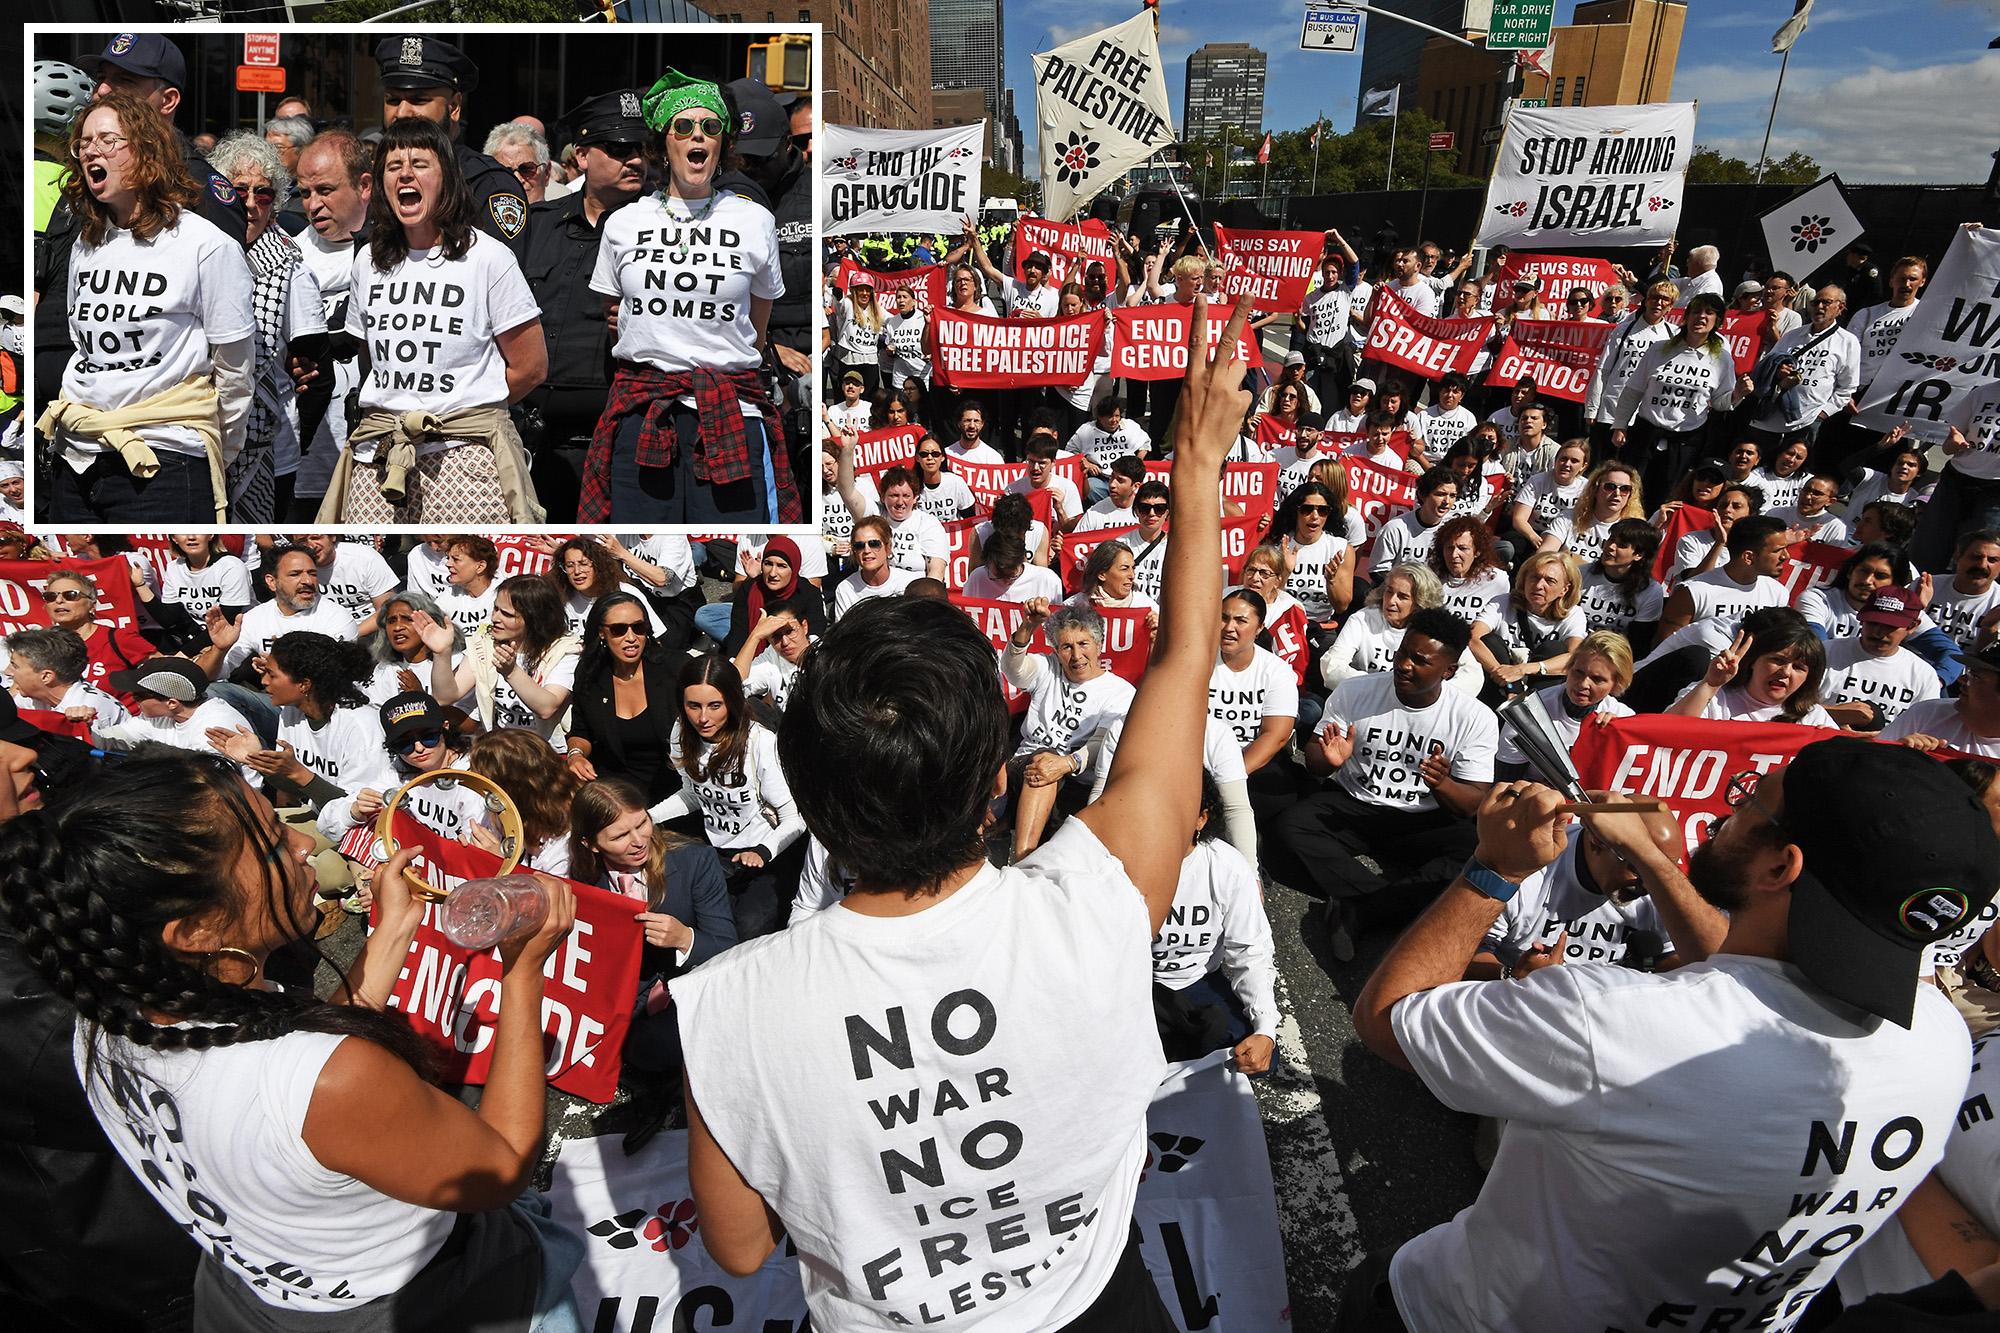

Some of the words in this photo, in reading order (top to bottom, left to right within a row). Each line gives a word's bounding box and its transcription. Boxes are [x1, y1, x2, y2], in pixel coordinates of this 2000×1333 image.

[1320, 13, 1334, 21] BUS
[1521, 4, 1551, 15] DRIVE
[1307, 23, 1333, 32] BUSES
[1335, 25, 1354, 34] ONLY
[1503, 18, 1538, 29] NORTH
[1489, 32, 1516, 42] KEEP
[1518, 32, 1548, 43] RIGHT
[1089, 39, 1151, 95] FREE
[1039, 54, 1166, 147] PALESTINE
[866, 150, 905, 177] END
[1520, 137, 1587, 175] STOP
[1589, 135, 1676, 175] ARMING
[831, 171, 967, 222] GENOCIDE
[1528, 184, 1645, 230] ISRAEL
[635, 227, 741, 248] FUND
[1024, 224, 1059, 247] STOP
[1225, 238, 1264, 252] JEWS
[1267, 238, 1302, 253] SAY
[632, 248, 742, 270] PEOPLE
[1247, 256, 1313, 278] ARMING
[1518, 262, 1568, 276] JEWS
[1571, 263, 1598, 277] SAY
[78, 270, 167, 296] FUND
[644, 269, 725, 295] NOT
[1225, 276, 1278, 300] ISRAEL
[367, 281, 465, 308] FUND
[631, 297, 736, 322] BOMBS
[367, 313, 463, 336] PEOPLE
[894, 329, 920, 337] FUND
[939, 320, 969, 345] NO
[972, 322, 1024, 348] WAR
[1025, 324, 1055, 349] NO
[1059, 324, 1091, 348] ICE
[1131, 318, 1182, 343] END
[1870, 328, 1901, 339] PEOP
[1873, 316, 1911, 330] FUN
[79, 330, 144, 355] NOT
[375, 339, 442, 364] NOT
[1367, 316, 1462, 373] ISRAEL
[1876, 338, 1897, 347] NO
[940, 347, 982, 373] FREE
[986, 349, 1090, 374] PALESTINE
[1662, 362, 1711, 378] FUND
[373, 369, 455, 393] BOMBS
[1499, 355, 1590, 393] GENOC
[1656, 373, 1709, 388] PEOPLE
[1651, 396, 1698, 411] BOMBS
[1661, 386, 1698, 398] NOT
[1884, 378, 1952, 422] IR
[1427, 428, 1464, 437] PEOPLE
[1429, 419, 1464, 428] FUND
[1978, 426, 2000, 441] NO
[853, 433, 916, 468] RMING
[1093, 443, 1129, 453] PEOPLE
[1094, 436, 1127, 445] FUND
[1431, 437, 1456, 447] NOT
[1100, 452, 1124, 462] NOT
[1225, 471, 1263, 496] ING
[1279, 469, 1308, 483] FUN
[1350, 466, 1399, 496] STOP
[822, 516, 852, 524] PEOP
[893, 533, 915, 541] ND
[1570, 546, 1601, 559] PEO
[1786, 559, 1839, 596] TH
[178, 586, 222, 598] FUND
[316, 584, 358, 595] UND
[1444, 596, 1483, 608] UND
[1579, 595, 1637, 618] FUND
[1062, 682, 1087, 704] NO
[1843, 676, 1914, 703] FUND
[1051, 709, 1080, 731] NO
[1206, 706, 1263, 721] PEOPL
[1366, 727, 1446, 757] FUND
[1361, 746, 1422, 769] PEOP
[1369, 763, 1425, 787] NOT
[1610, 744, 1728, 799] END
[694, 783, 751, 804] EOPLE
[409, 797, 459, 828] UND
[844, 988, 998, 1081] NO
[867, 1067, 1012, 1131] WAR
[879, 1119, 1024, 1195] NO
[1800, 1115, 1924, 1177] NO
[913, 1180, 1020, 1226] ICE
[1787, 1186, 1898, 1218] WAR
[861, 1191, 1084, 1301] FREE
[1740, 1224, 1864, 1264] NO
[1731, 1266, 1817, 1296] ICE
